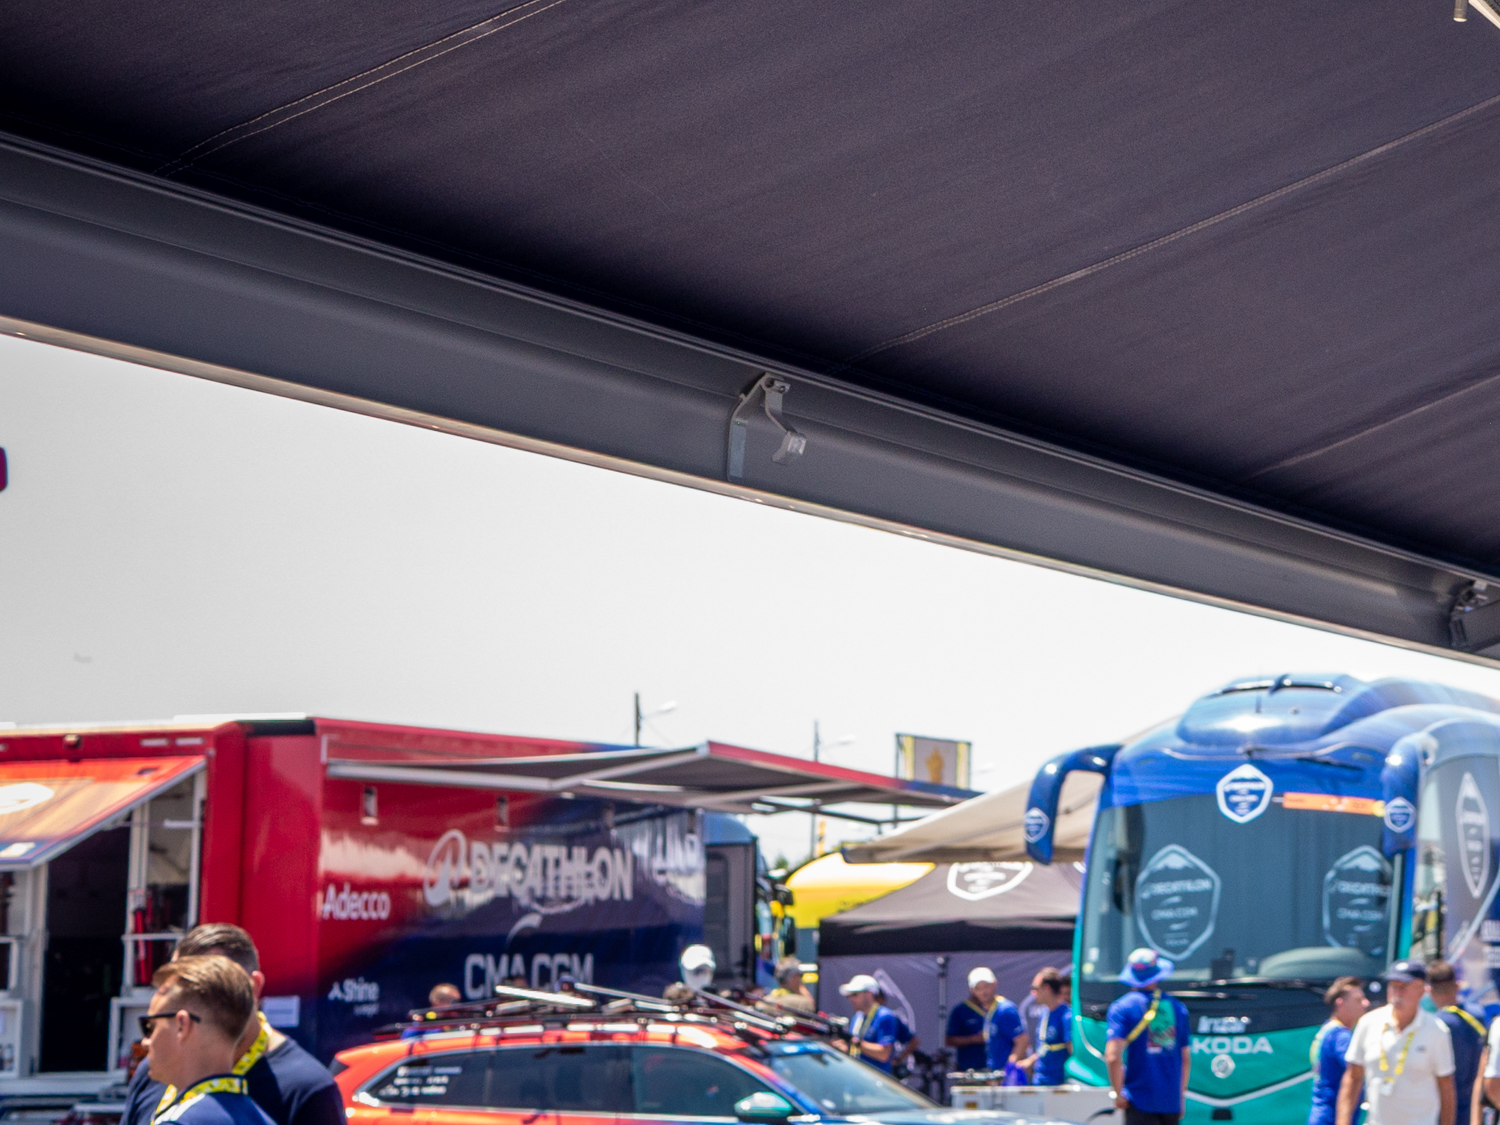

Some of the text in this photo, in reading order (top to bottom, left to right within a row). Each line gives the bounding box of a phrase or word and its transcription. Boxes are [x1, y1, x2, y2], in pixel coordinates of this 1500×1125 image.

[470, 841, 634, 901] DECATHLON
[322, 881, 392, 920] Adecco
[1192, 1036, 1274, 1055] KODA
